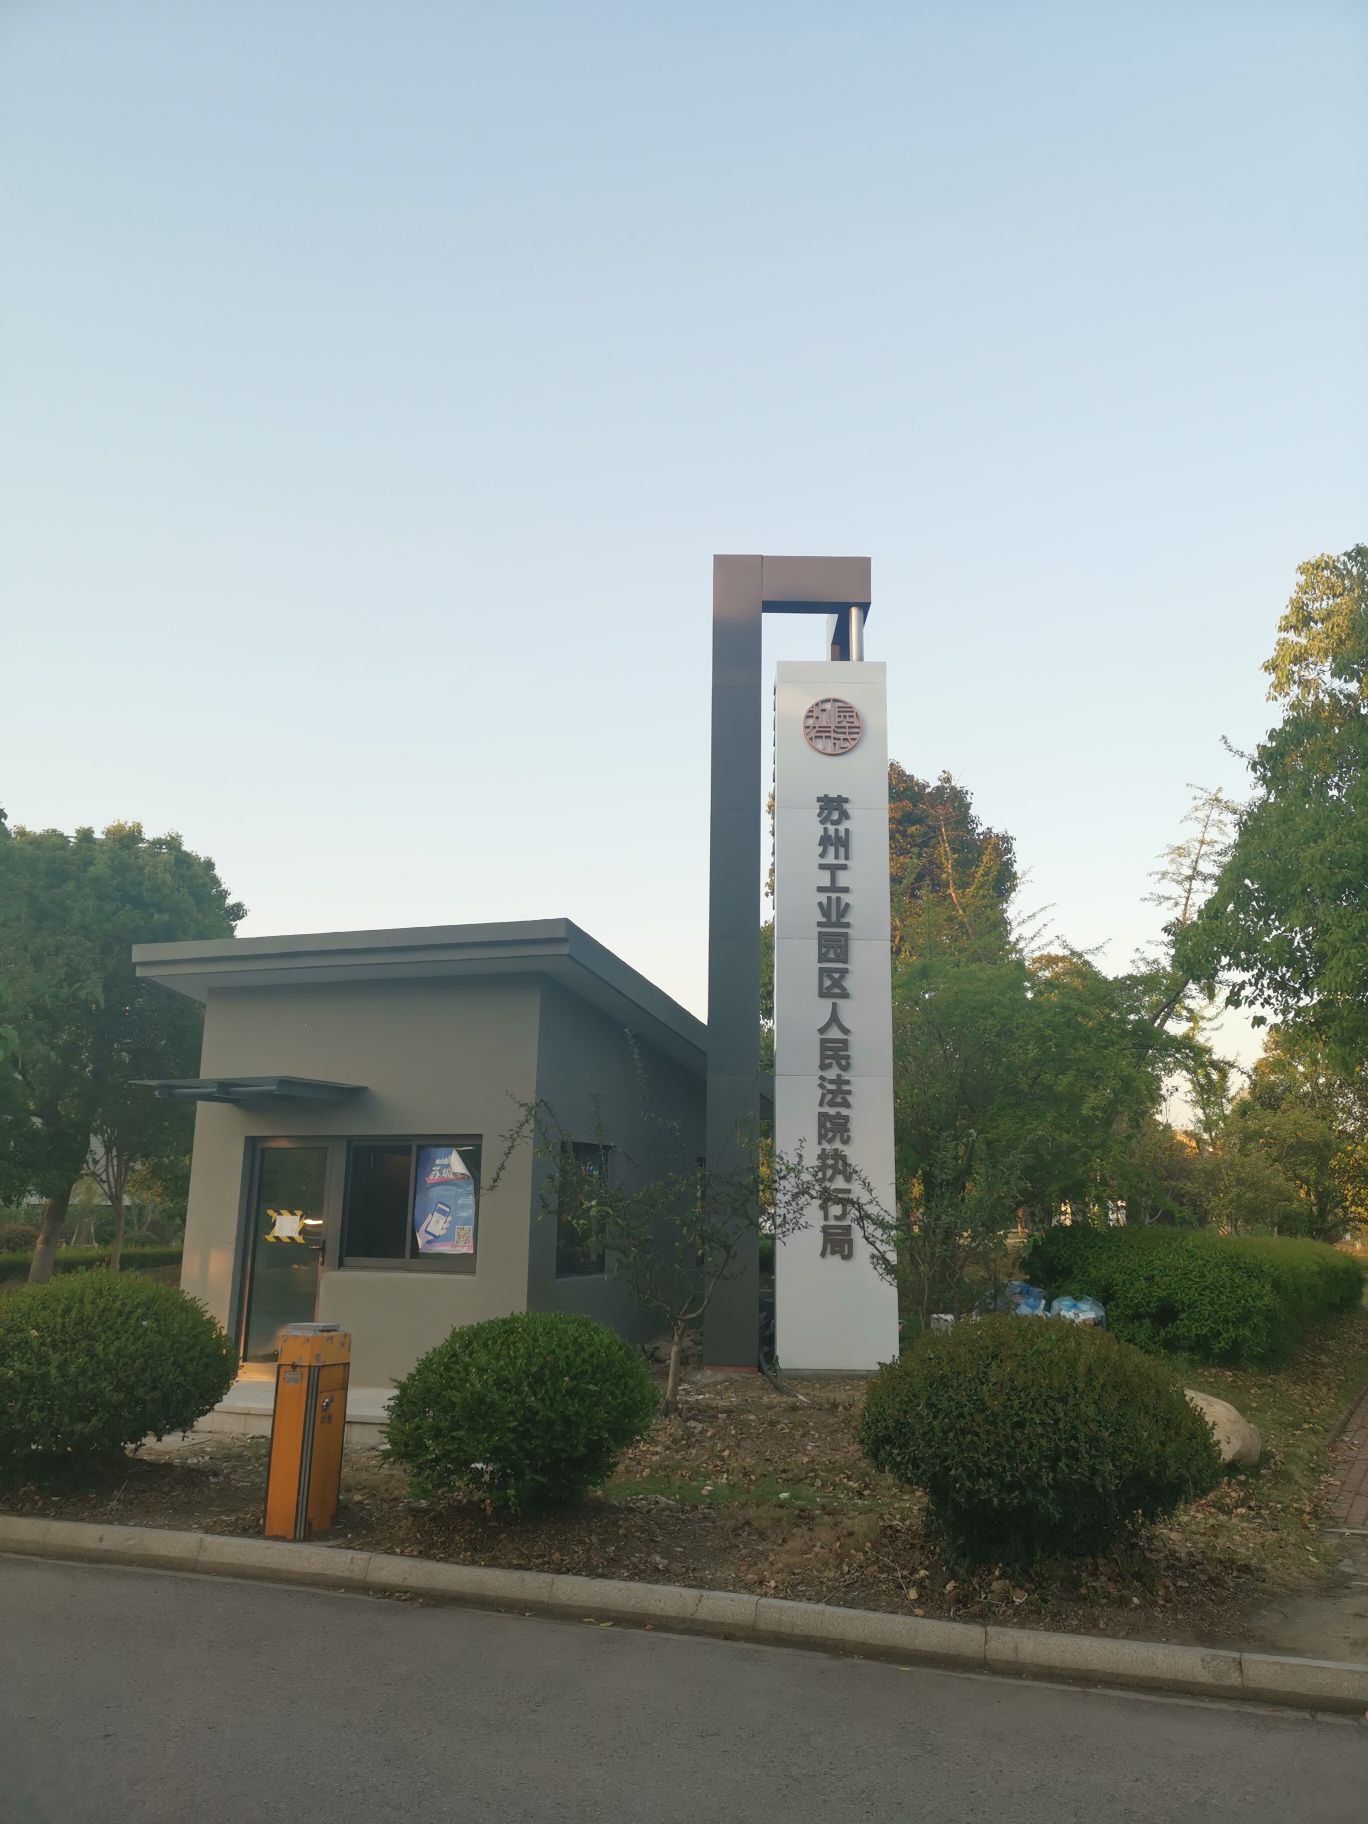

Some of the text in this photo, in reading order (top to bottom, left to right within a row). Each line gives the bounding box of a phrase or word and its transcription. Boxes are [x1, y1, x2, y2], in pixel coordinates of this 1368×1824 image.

[816, 794, 854, 1261] 苏州工业园区人民法院执行局
